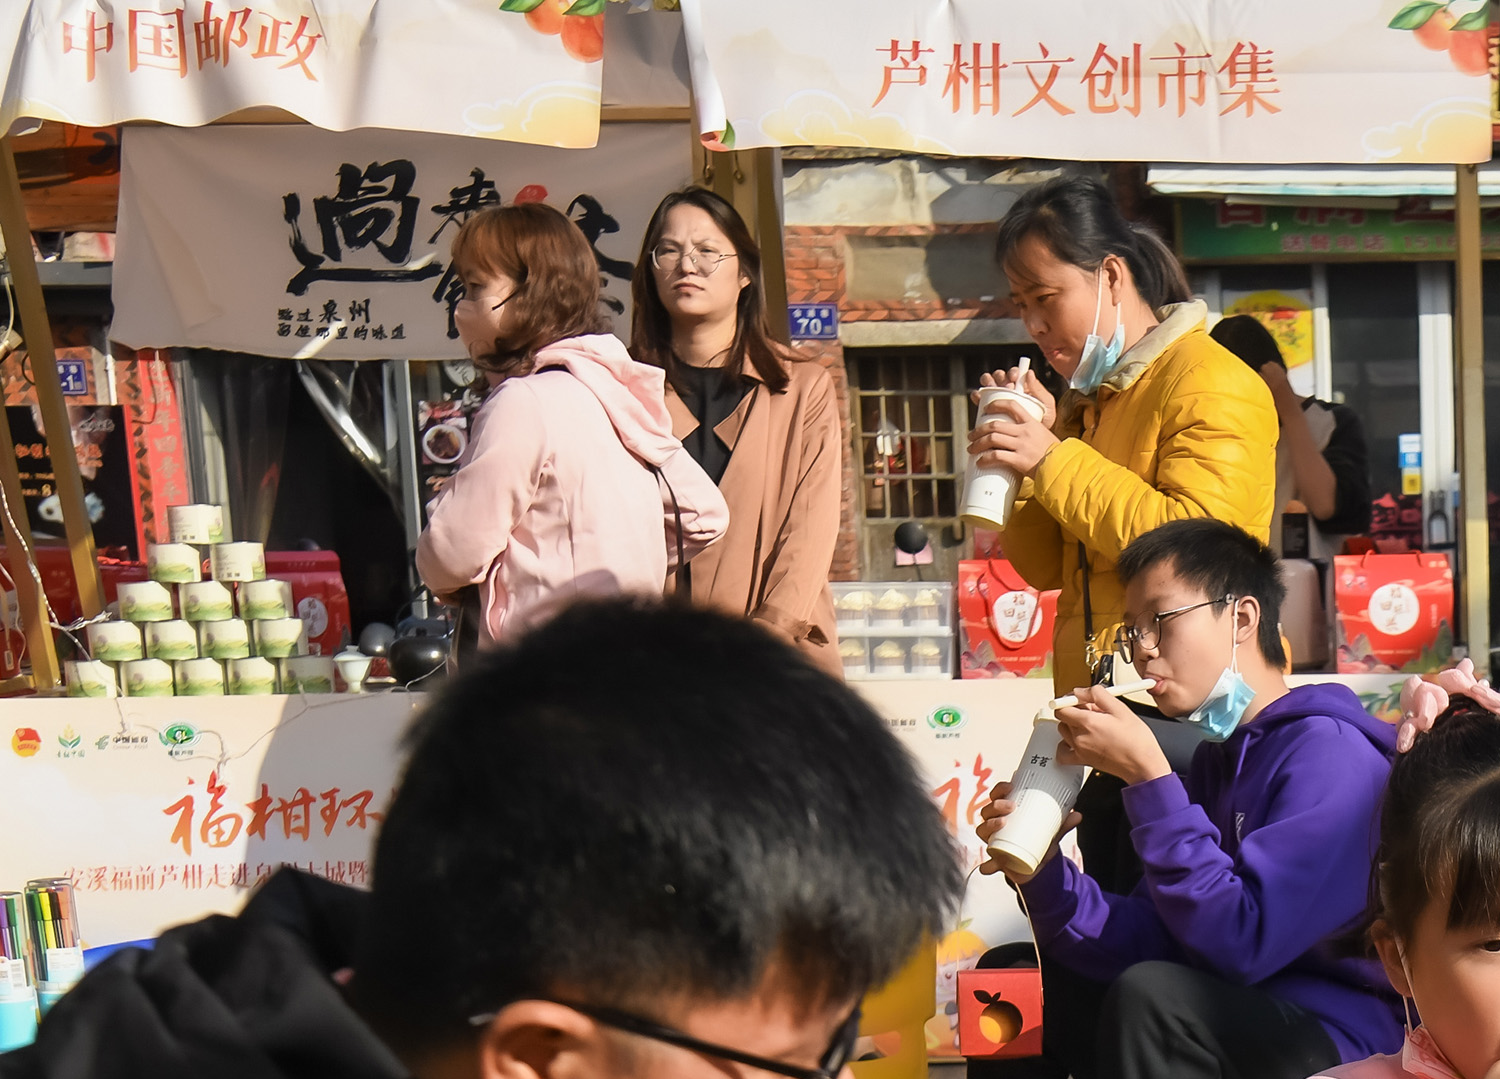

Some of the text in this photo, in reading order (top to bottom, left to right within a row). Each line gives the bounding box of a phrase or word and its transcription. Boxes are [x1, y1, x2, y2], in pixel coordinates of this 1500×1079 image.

[62, 1, 323, 82] 中国邮政
[872, 38, 1282, 118] 芦柑文创市集
[277, 298, 371, 323] 路过泉州
[796, 317, 822, 335] 70
